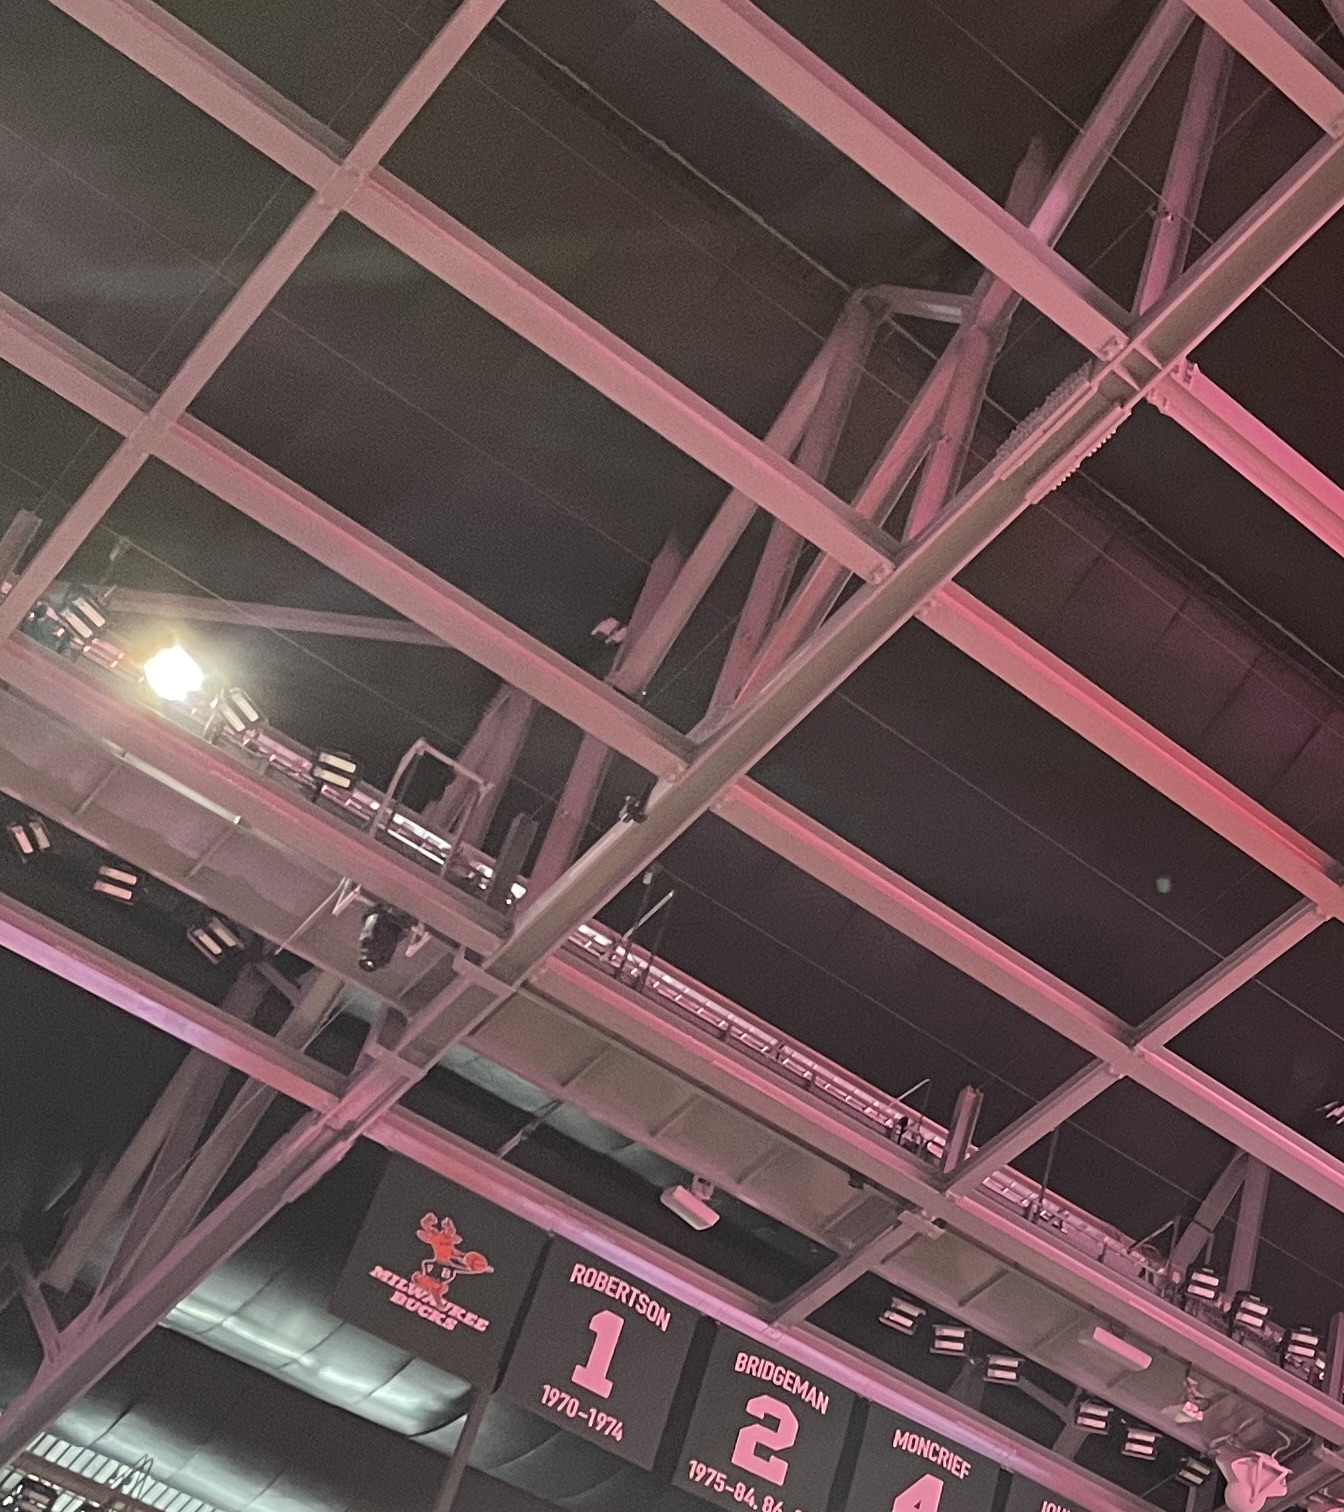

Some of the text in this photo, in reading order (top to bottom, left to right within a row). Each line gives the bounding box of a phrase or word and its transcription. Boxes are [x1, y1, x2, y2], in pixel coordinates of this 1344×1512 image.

[368, 1265, 490, 1332] MILWAUKEE
[389, 1290, 458, 1330] BUCKS
[569, 1263, 671, 1332] ROBERTSON
[571, 1309, 625, 1399] 1
[734, 1352, 829, 1415] BRIDGEMAN
[540, 1384, 625, 1442] 1970-1974
[731, 1394, 799, 1486] 2
[892, 1429, 971, 1480] MONCRIEF
